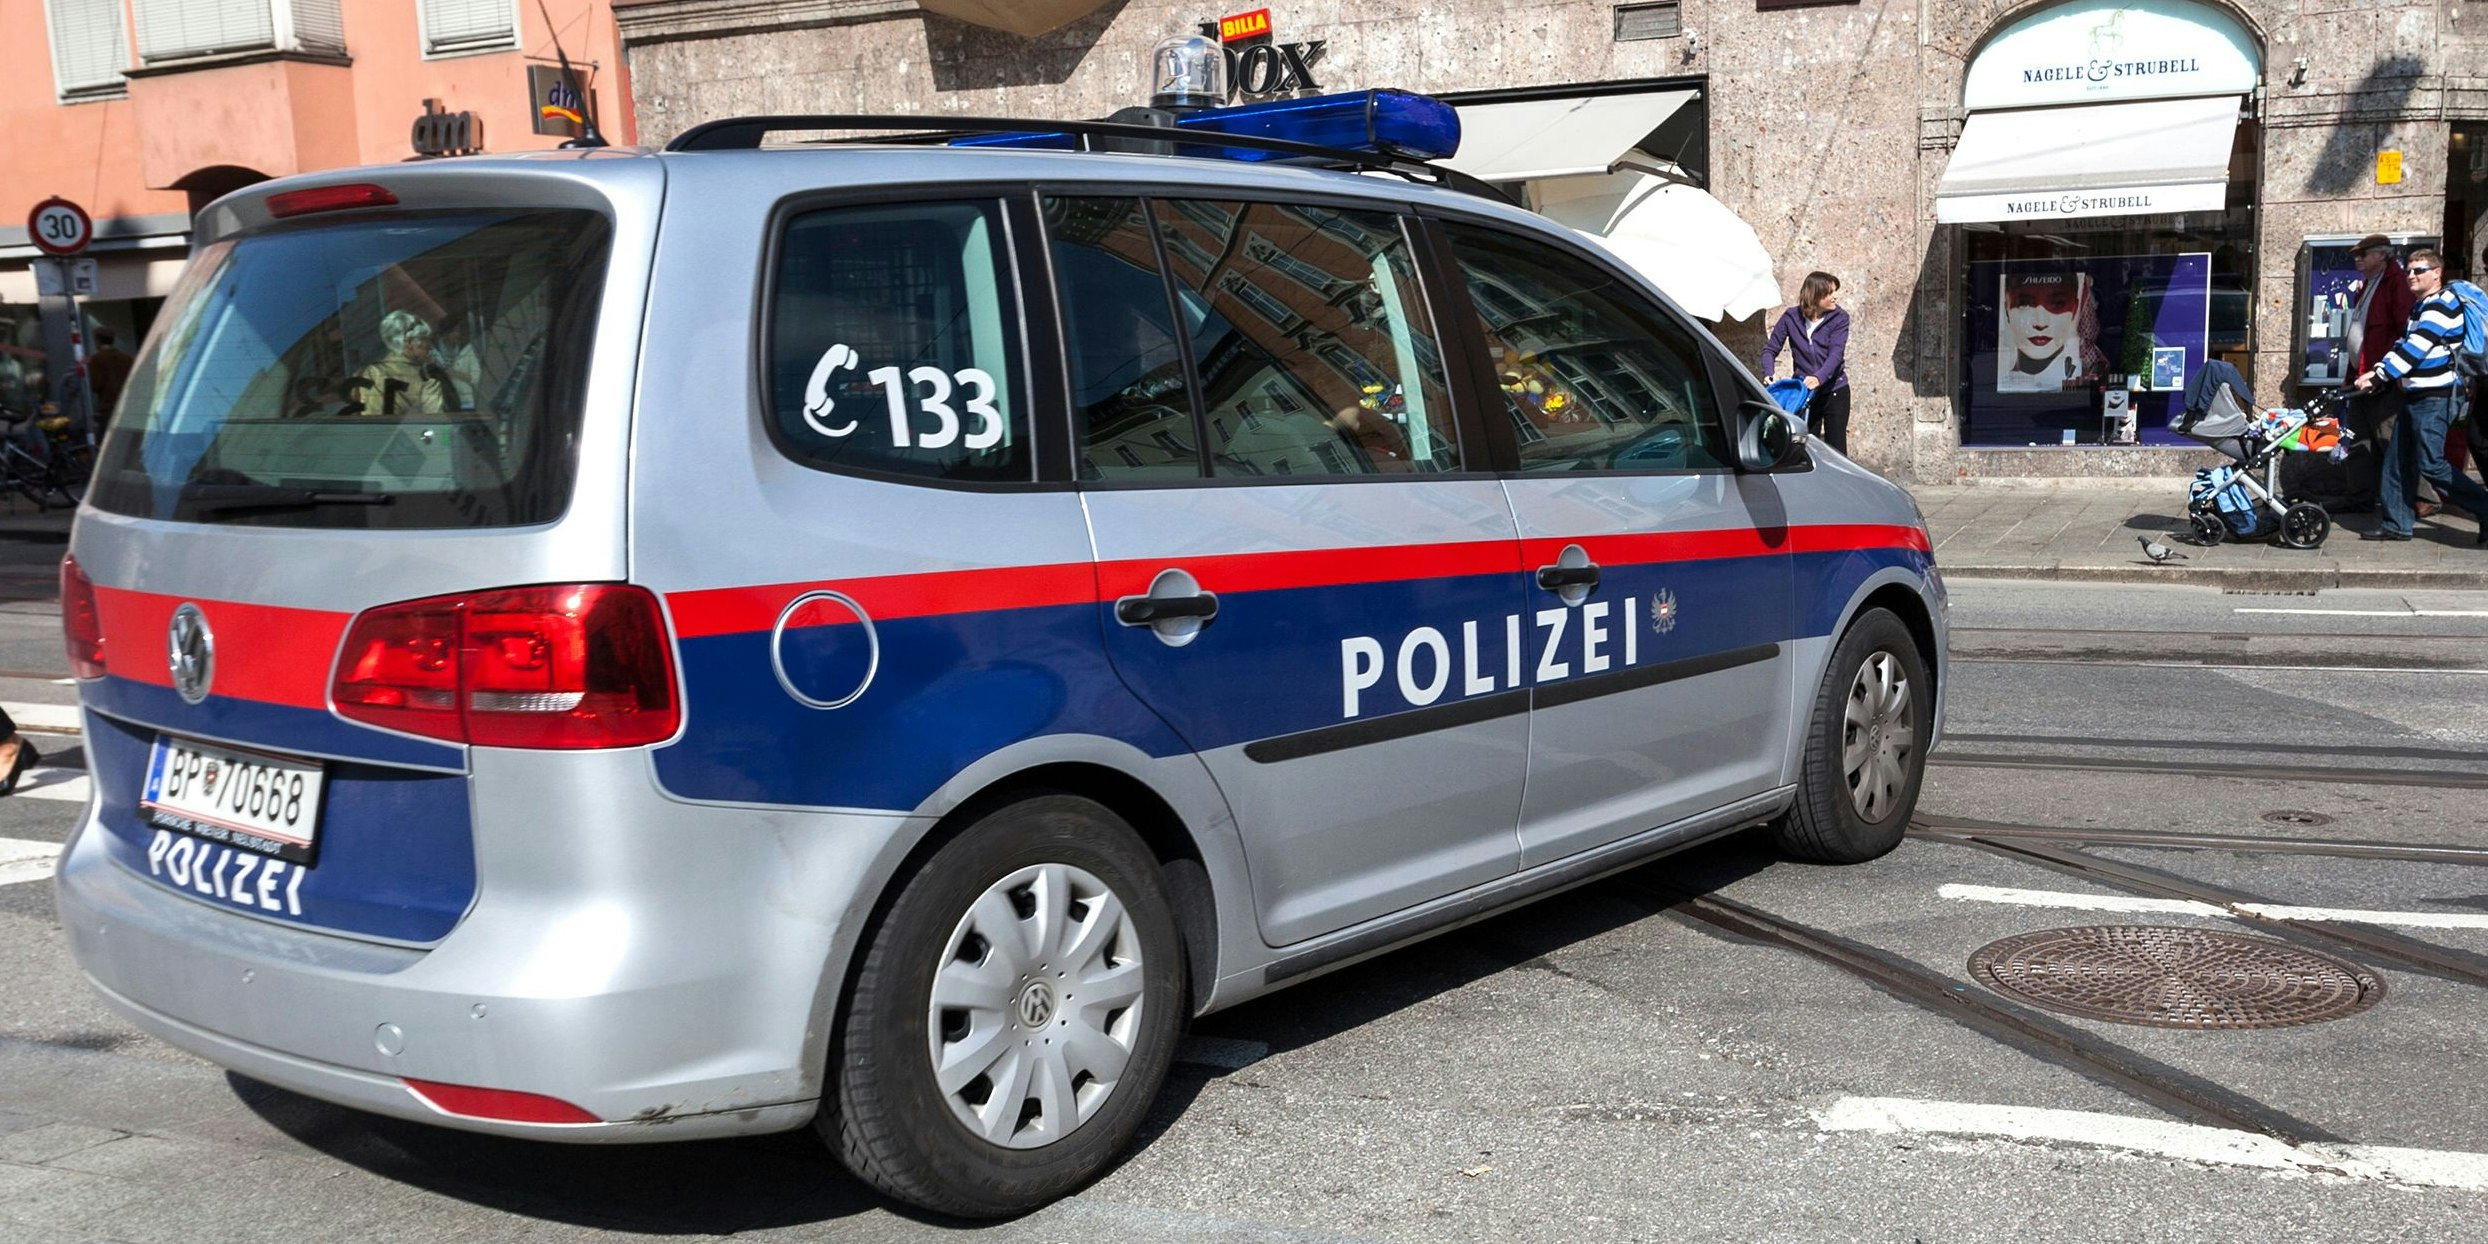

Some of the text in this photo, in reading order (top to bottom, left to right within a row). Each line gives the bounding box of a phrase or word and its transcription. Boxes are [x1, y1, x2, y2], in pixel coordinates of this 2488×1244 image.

[1223, 14, 1267, 37] BILLA
[2087, 59, 2113, 82] &
[2114, 58, 2200, 77] STRUBELL
[411, 98, 481, 155] dm
[2060, 196, 2080, 213] &
[2081, 196, 2151, 209] STRUBELL
[44, 214, 76, 239] 30
[2022, 275, 2062, 285] SHISEIDO
[867, 366, 1004, 449] 133
[1341, 597, 1637, 718] POLIZEI
[168, 749, 201, 800] BP
[216, 758, 304, 826] 70668
[148, 830, 306, 916] POLIZEI
